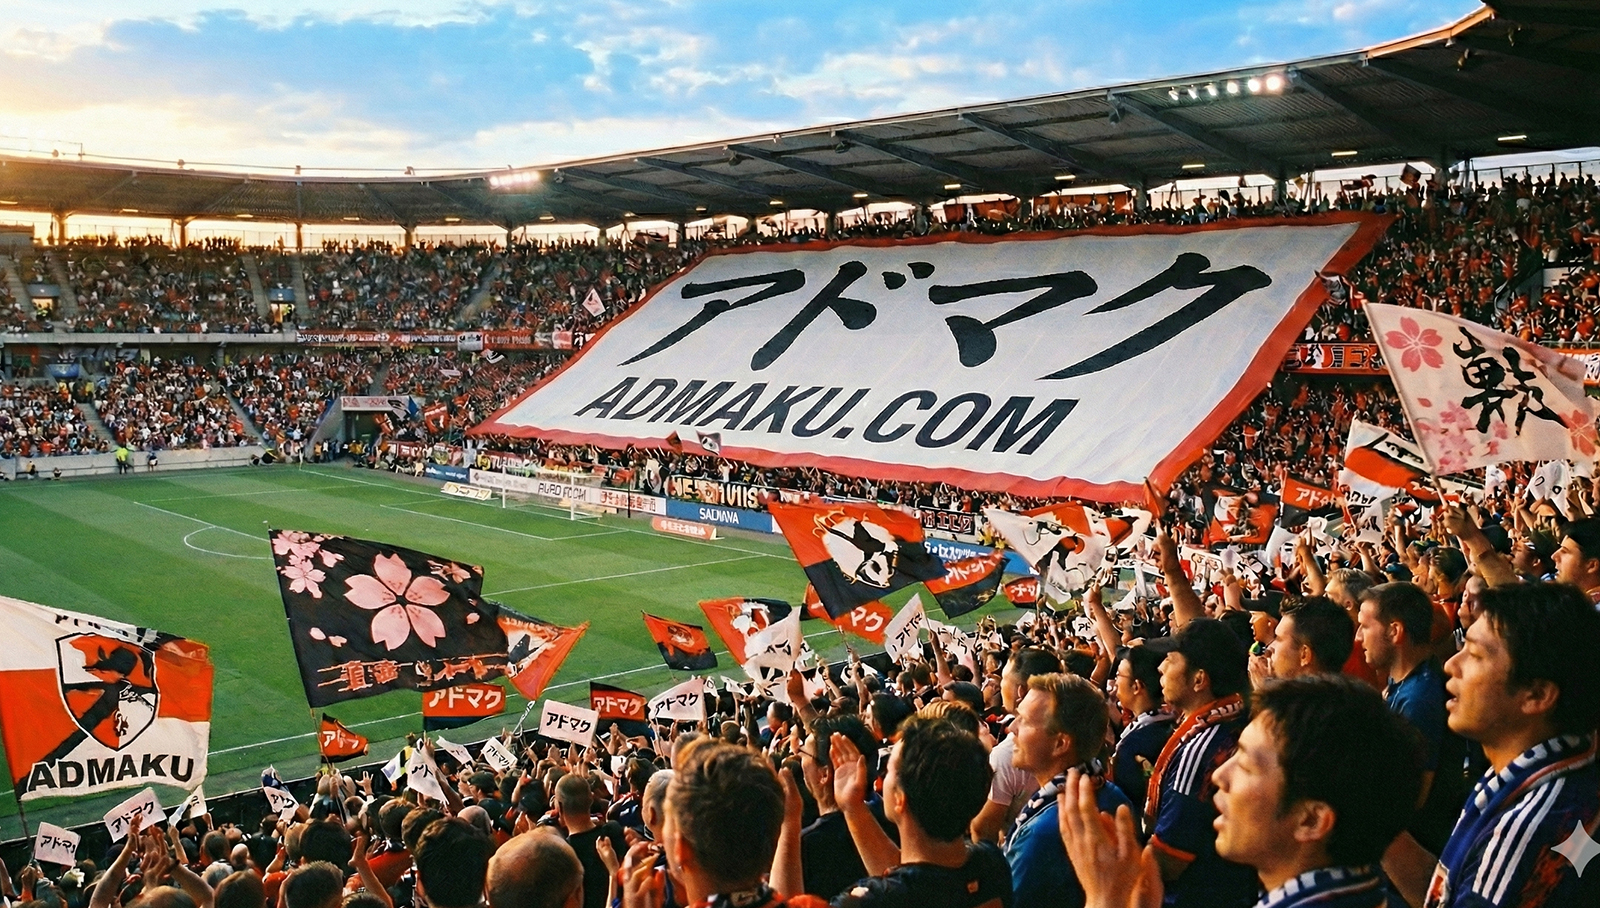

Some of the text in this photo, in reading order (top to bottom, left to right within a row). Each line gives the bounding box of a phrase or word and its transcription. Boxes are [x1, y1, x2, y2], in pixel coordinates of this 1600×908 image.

[620, 252, 1272, 380] アドマク
[574, 377, 1079, 455] ADMAKU.COM
[429, 687, 502, 709] アドマク
[594, 696, 641, 716] アドマク
[655, 692, 699, 715] アドマク
[546, 711, 592, 733] アドマク
[27, 753, 195, 792] ADMAKU
